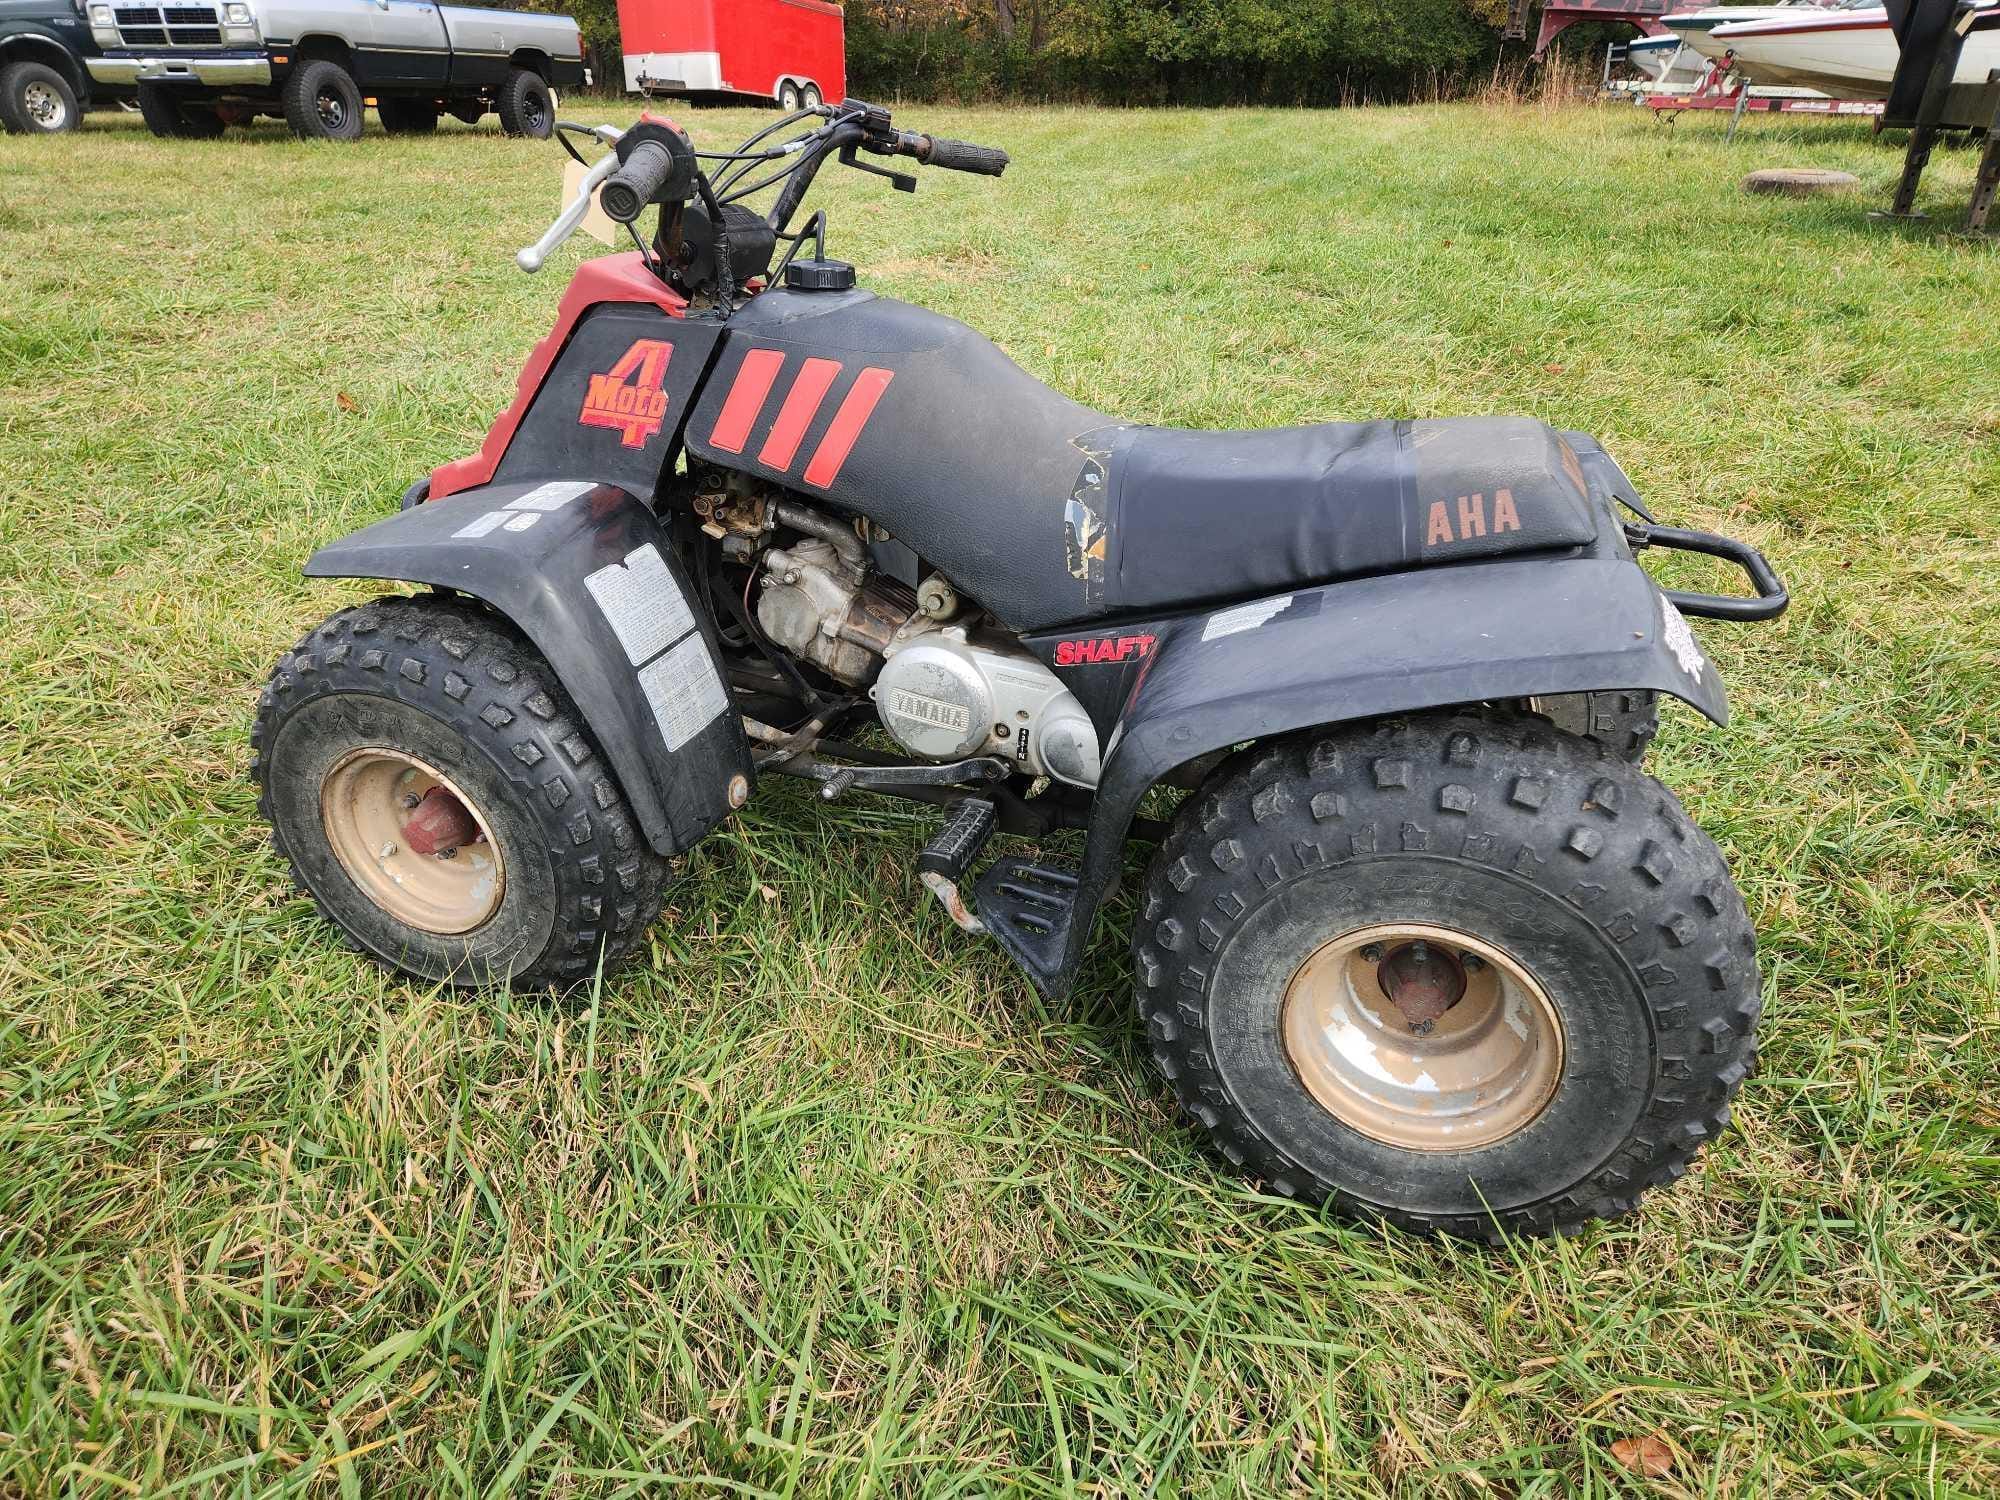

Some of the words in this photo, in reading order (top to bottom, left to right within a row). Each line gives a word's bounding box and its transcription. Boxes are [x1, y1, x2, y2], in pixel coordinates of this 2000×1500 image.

[578, 337, 675, 451] 4
[1056, 634, 1157, 665] SHAFT
[896, 693, 962, 727] YAMAHA
